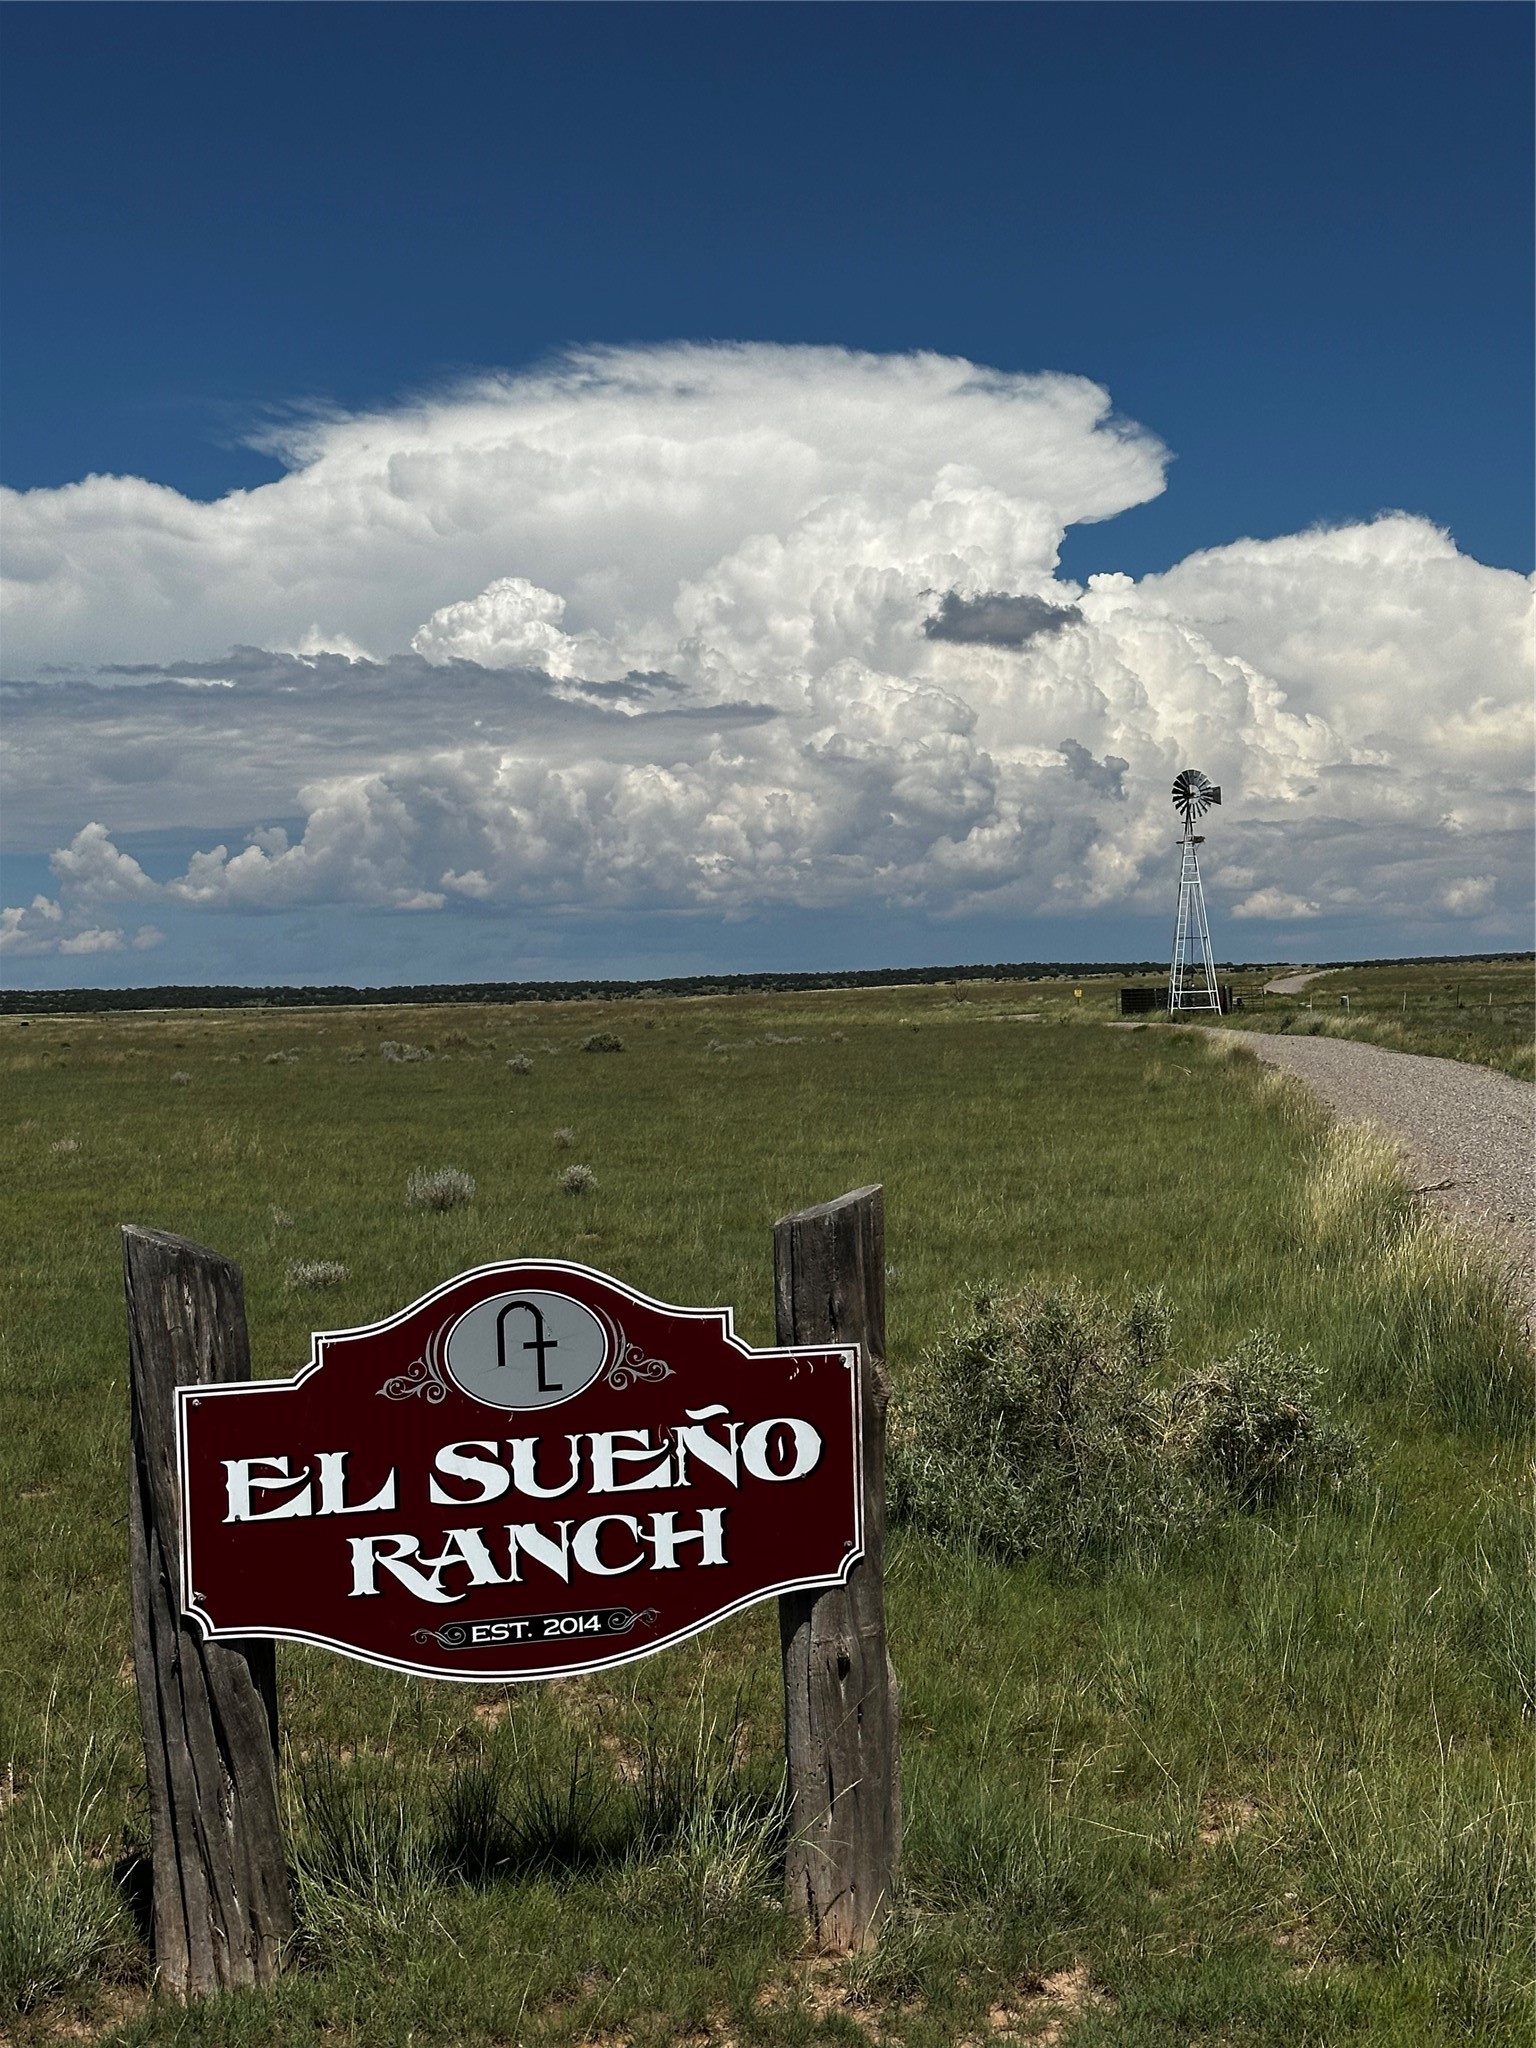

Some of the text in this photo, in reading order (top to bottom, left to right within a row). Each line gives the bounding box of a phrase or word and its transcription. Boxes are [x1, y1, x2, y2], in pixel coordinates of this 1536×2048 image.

[220, 1404, 822, 1523] EL SUEÑO
[347, 1507, 728, 1604] RANCH
[470, 1615, 602, 1643] EST. 2014
